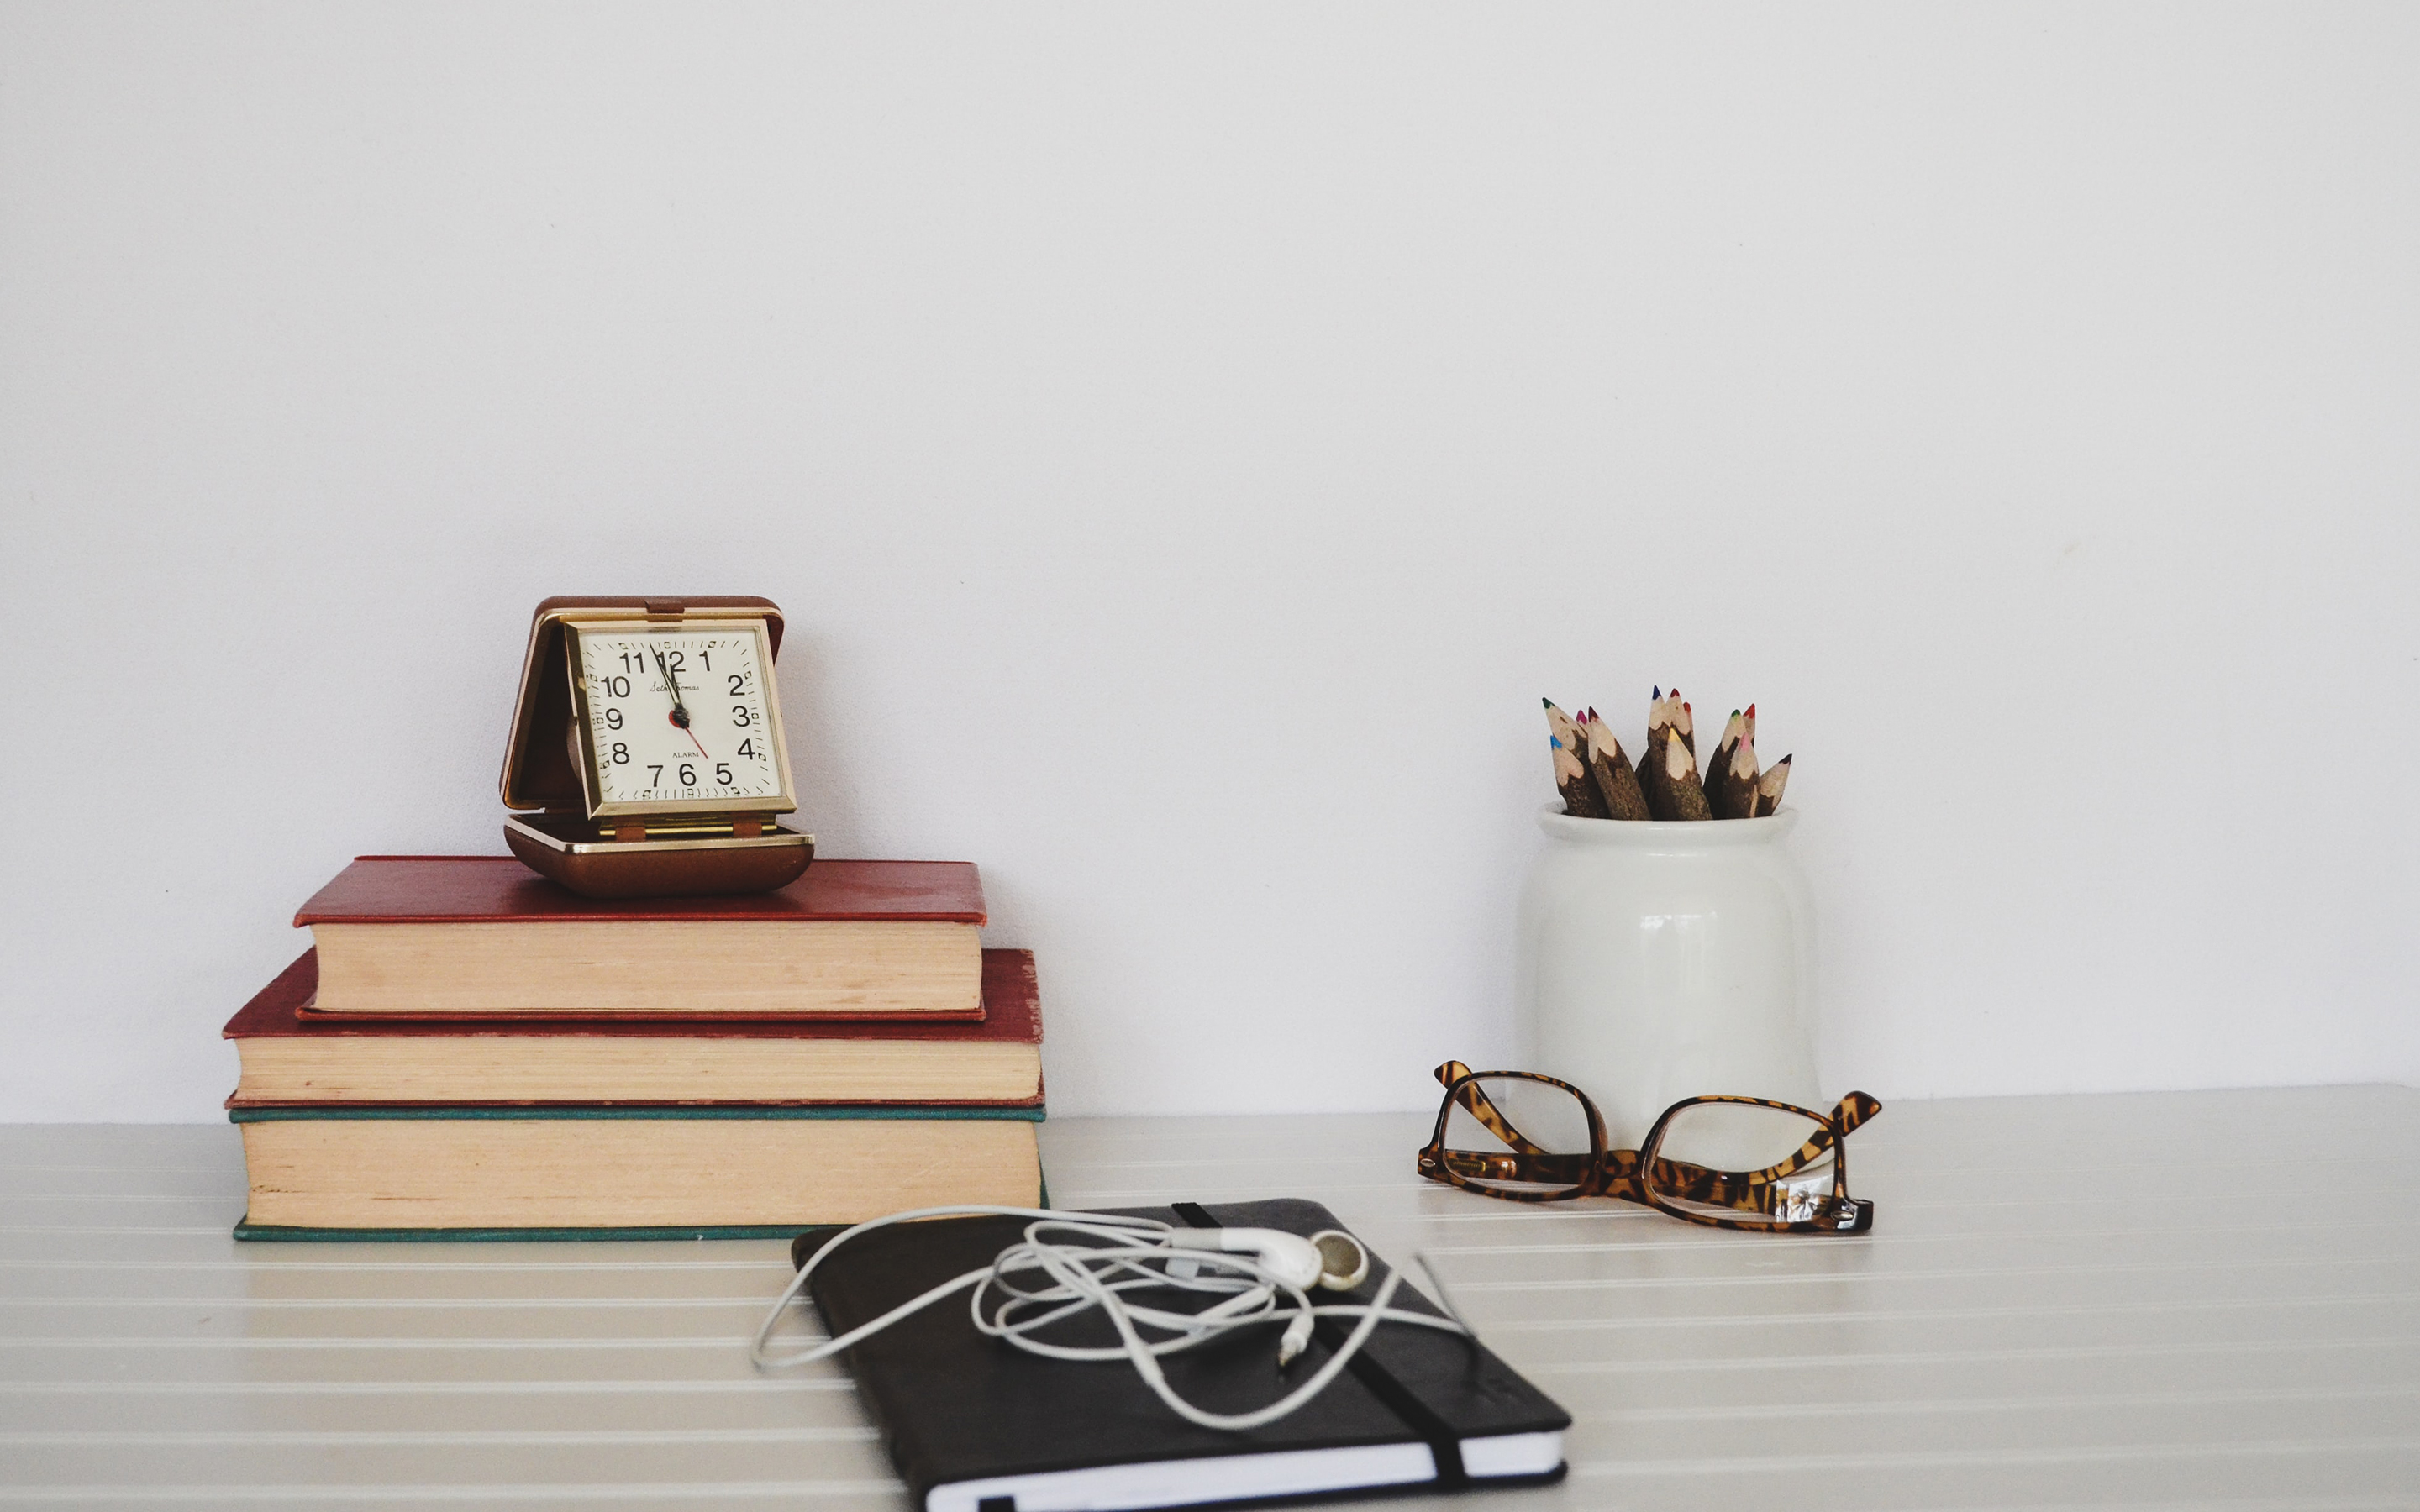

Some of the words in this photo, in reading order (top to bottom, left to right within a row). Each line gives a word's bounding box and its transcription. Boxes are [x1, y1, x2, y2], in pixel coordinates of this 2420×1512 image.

[619, 652, 645, 674] 11
[656, 651, 687, 673] 12
[699, 650, 711, 672] 1
[601, 676, 630, 698] 10
[728, 675, 745, 696] 2
[606, 708, 623, 730] 9
[733, 706, 750, 727] 3
[612, 743, 630, 764] 8
[737, 738, 755, 760] 4
[647, 765, 664, 787] 7
[679, 764, 697, 786] 6
[716, 763, 733, 785] 5
